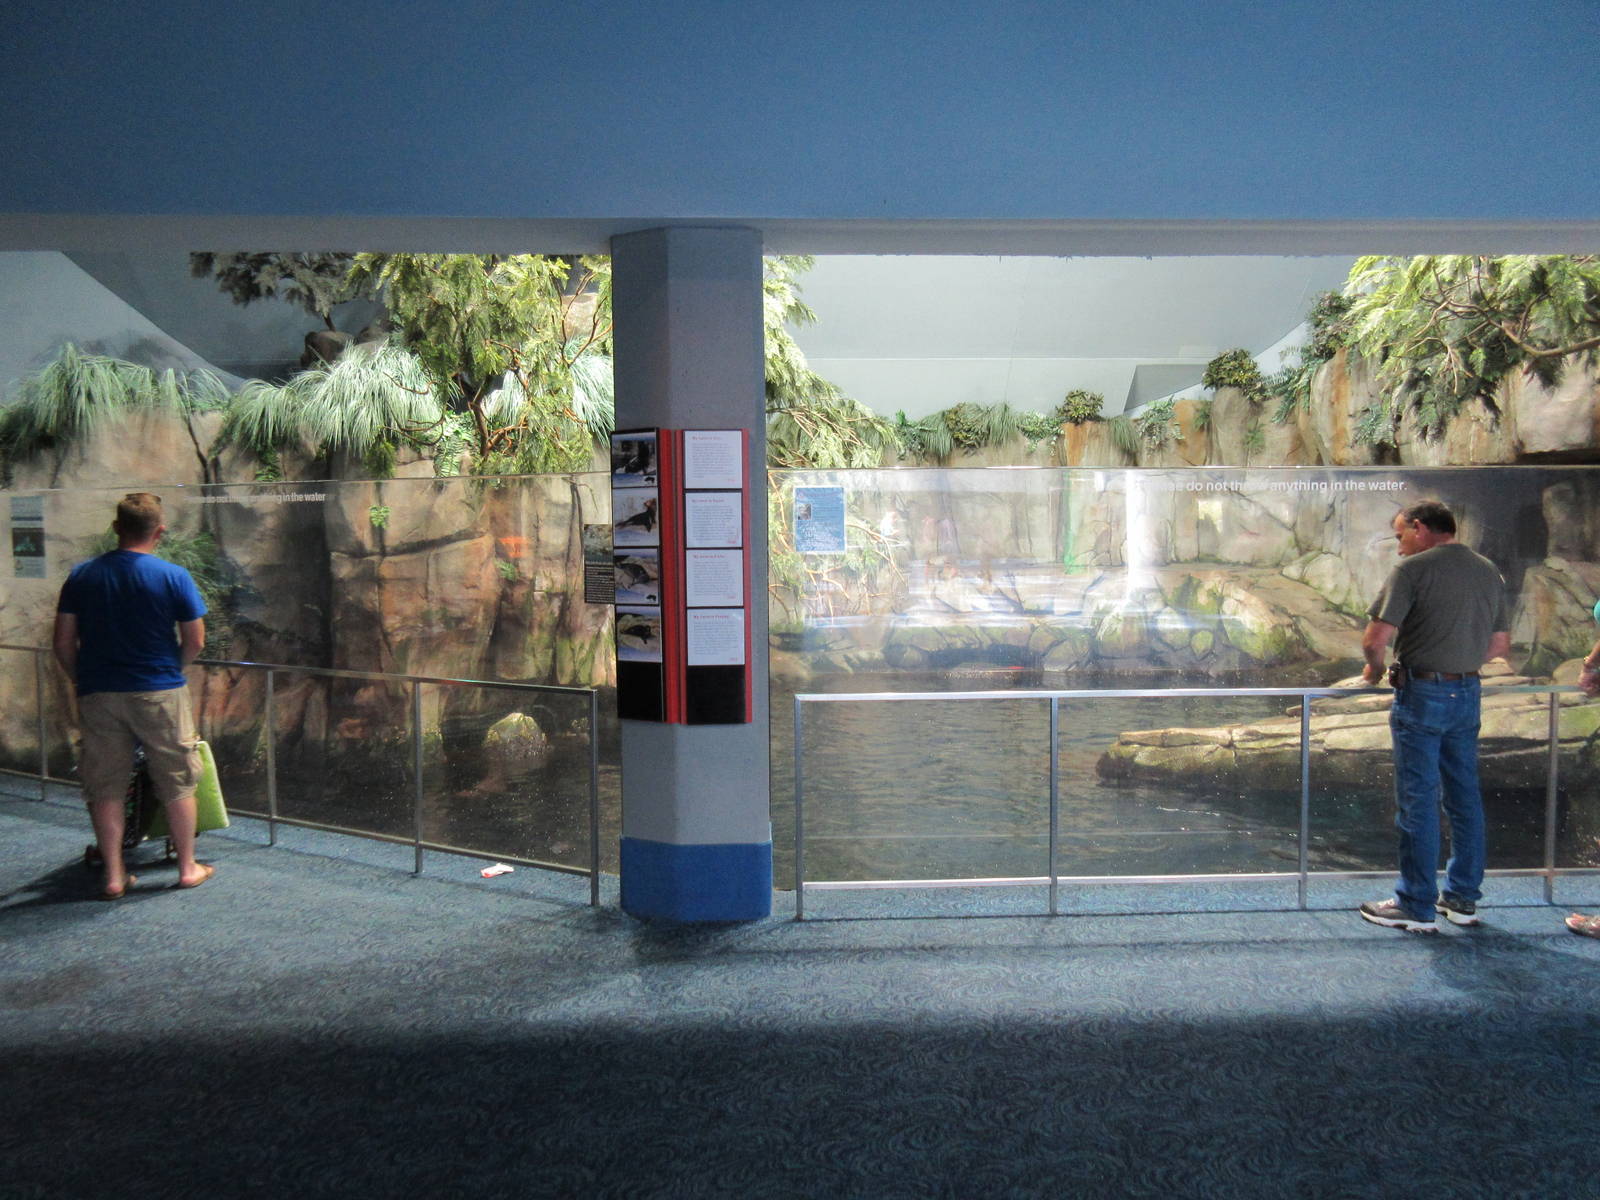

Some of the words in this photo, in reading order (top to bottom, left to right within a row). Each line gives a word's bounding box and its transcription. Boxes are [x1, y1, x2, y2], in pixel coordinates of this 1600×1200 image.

[1186, 480, 1203, 492] do
[1206, 481, 1227, 492] not
[1271, 480, 1328, 495] anything
[1331, 480, 1343, 491] in
[1345, 479, 1365, 491] the
[291, 492, 304, 502] the
